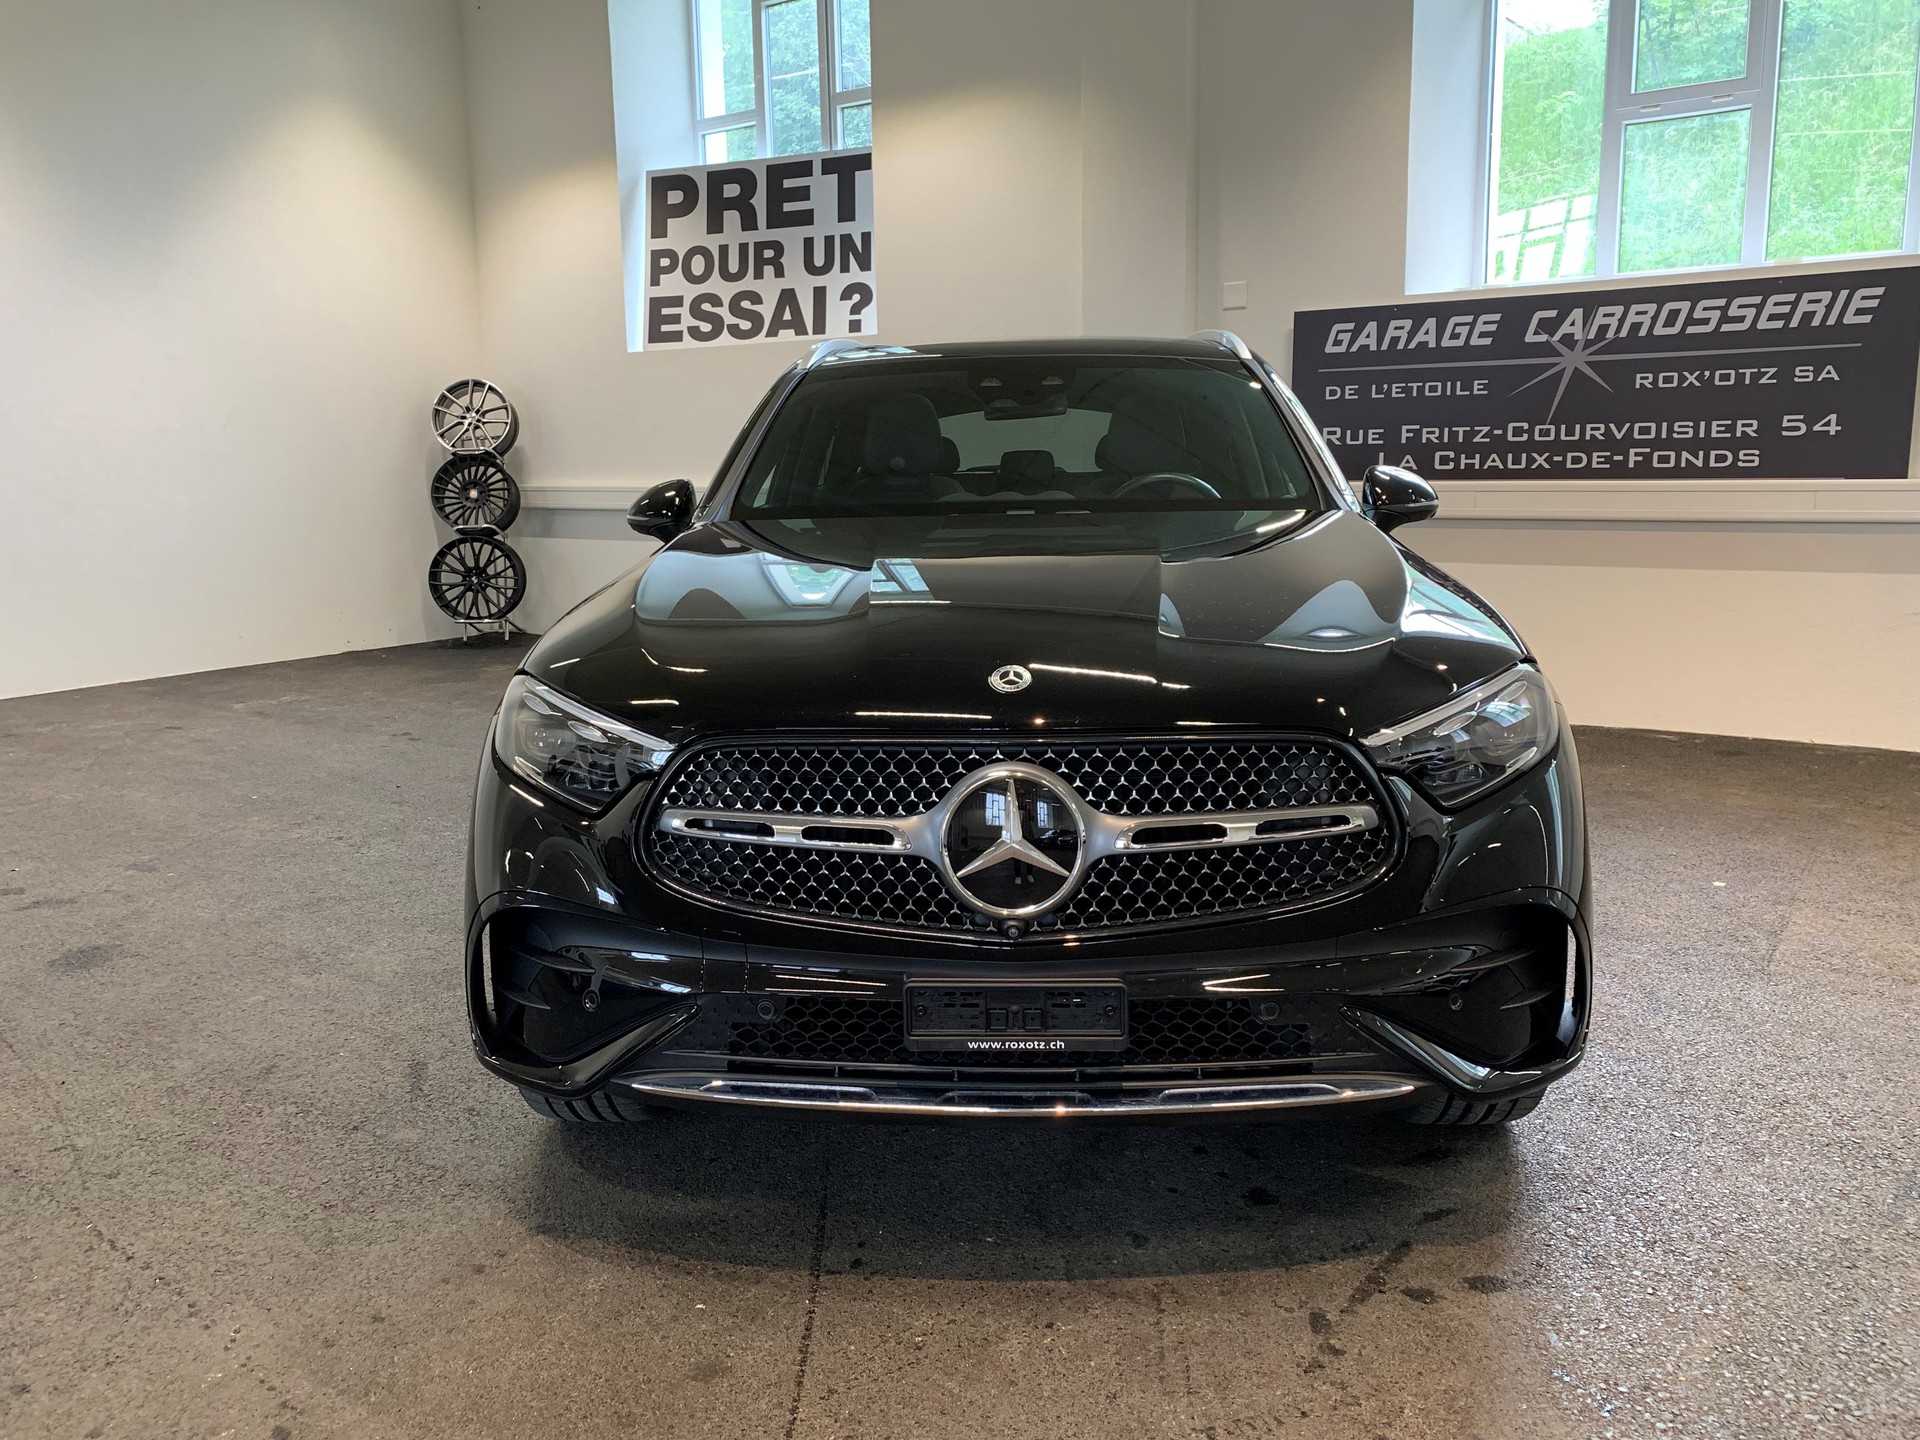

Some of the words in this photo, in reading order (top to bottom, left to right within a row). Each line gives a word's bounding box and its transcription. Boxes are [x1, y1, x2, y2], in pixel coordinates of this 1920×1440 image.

[650, 153, 872, 239] PRET
[650, 239, 786, 287] POUR
[803, 231, 872, 276] UN
[648, 285, 828, 344] ESSAI
[839, 281, 874, 333] ?
[1324, 313, 1502, 353] GARAGE
[1524, 286, 1886, 343] CARROSSERIE
[1325, 385, 1359, 400] DE
[1371, 379, 1489, 398] L'ETOILE
[1635, 367, 1778, 389] ROX'OTZ
[1793, 364, 1841, 383] SA
[1781, 413, 1842, 436] 54
[967, 1039, 1065, 1050] www.roxotz.ch
